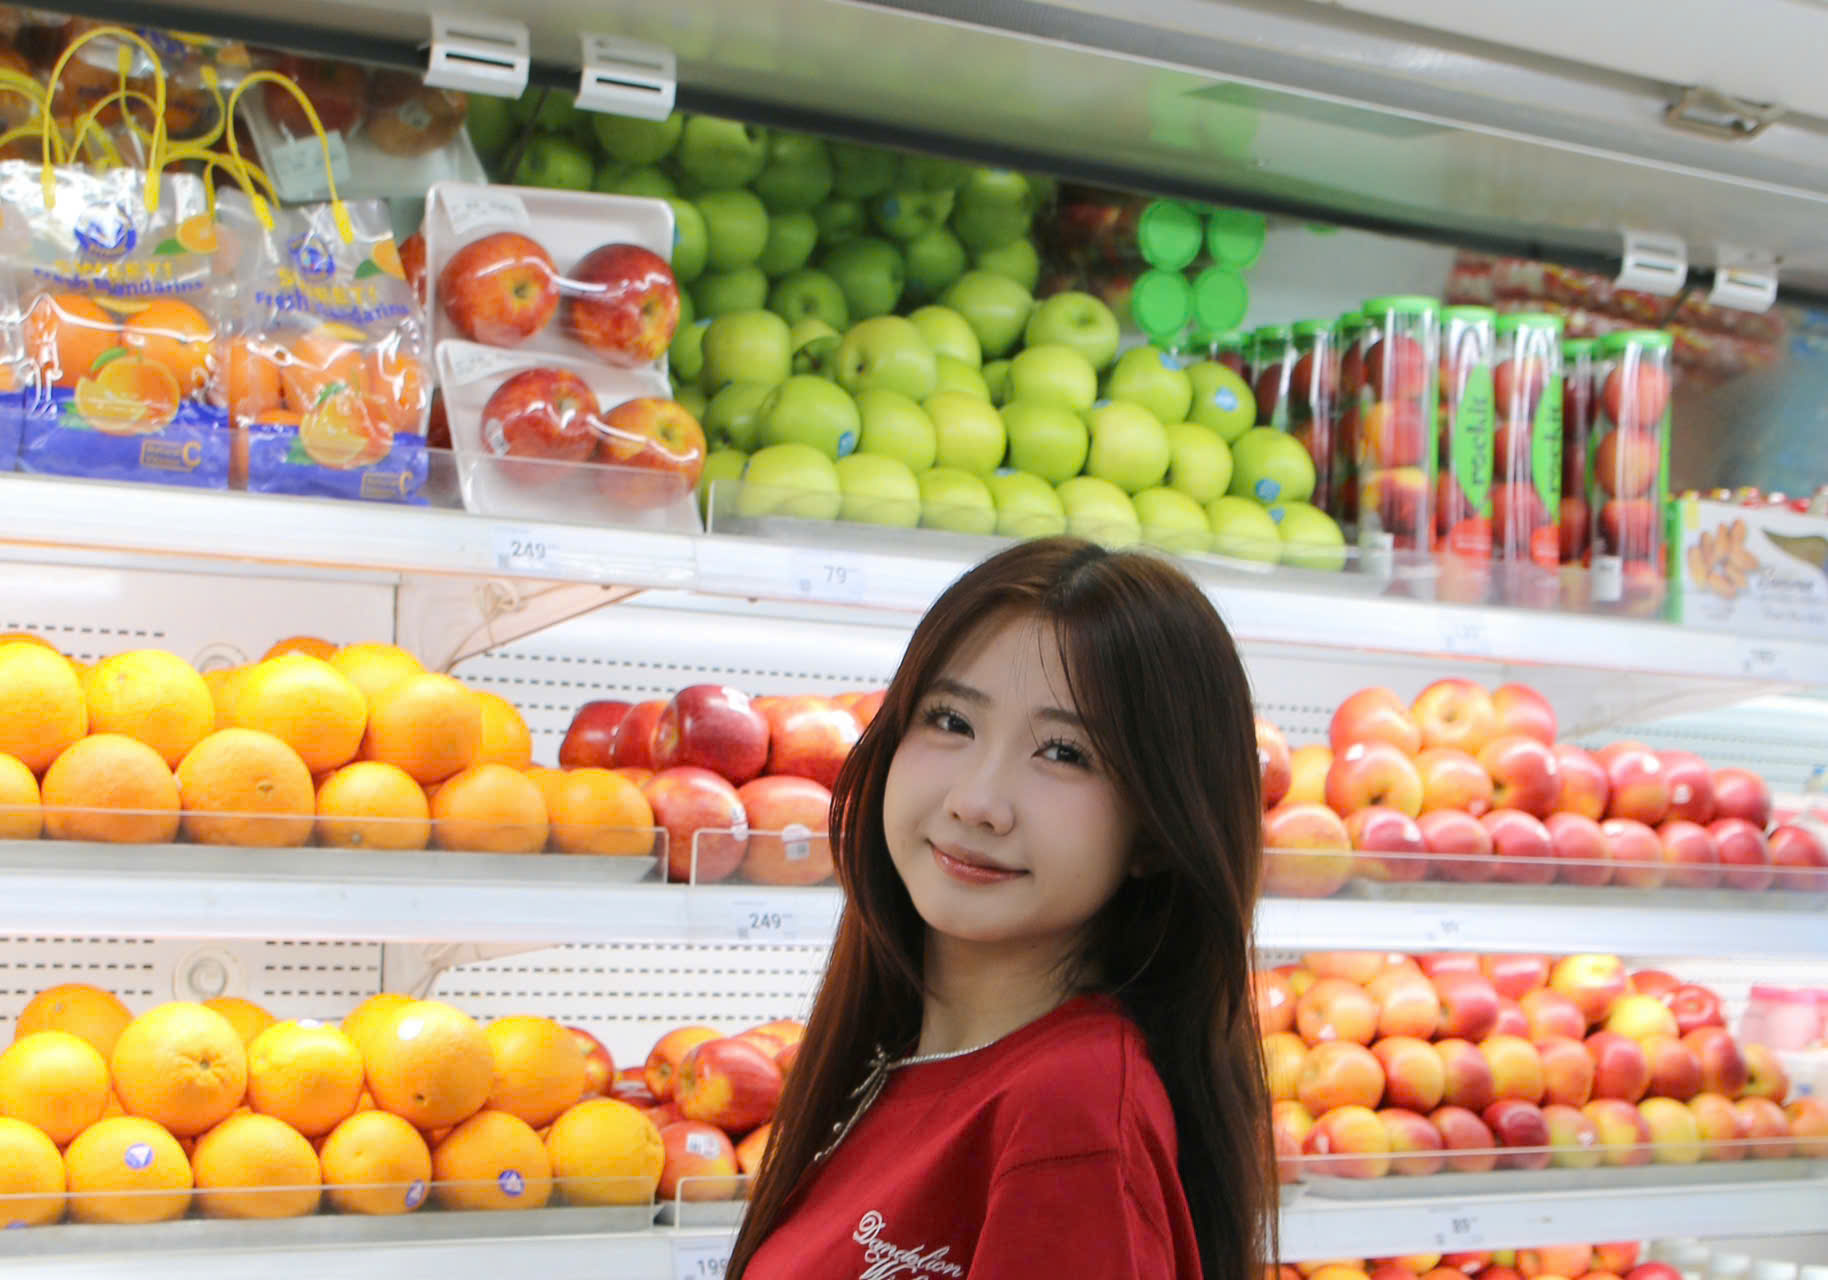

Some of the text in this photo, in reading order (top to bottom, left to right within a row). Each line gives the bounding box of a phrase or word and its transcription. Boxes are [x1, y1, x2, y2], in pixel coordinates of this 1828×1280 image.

[510, 539, 546, 559] 249
[823, 565, 847, 584] 79
[748, 912, 782, 929] 249
[852, 1209, 964, 1278] Dandelion
